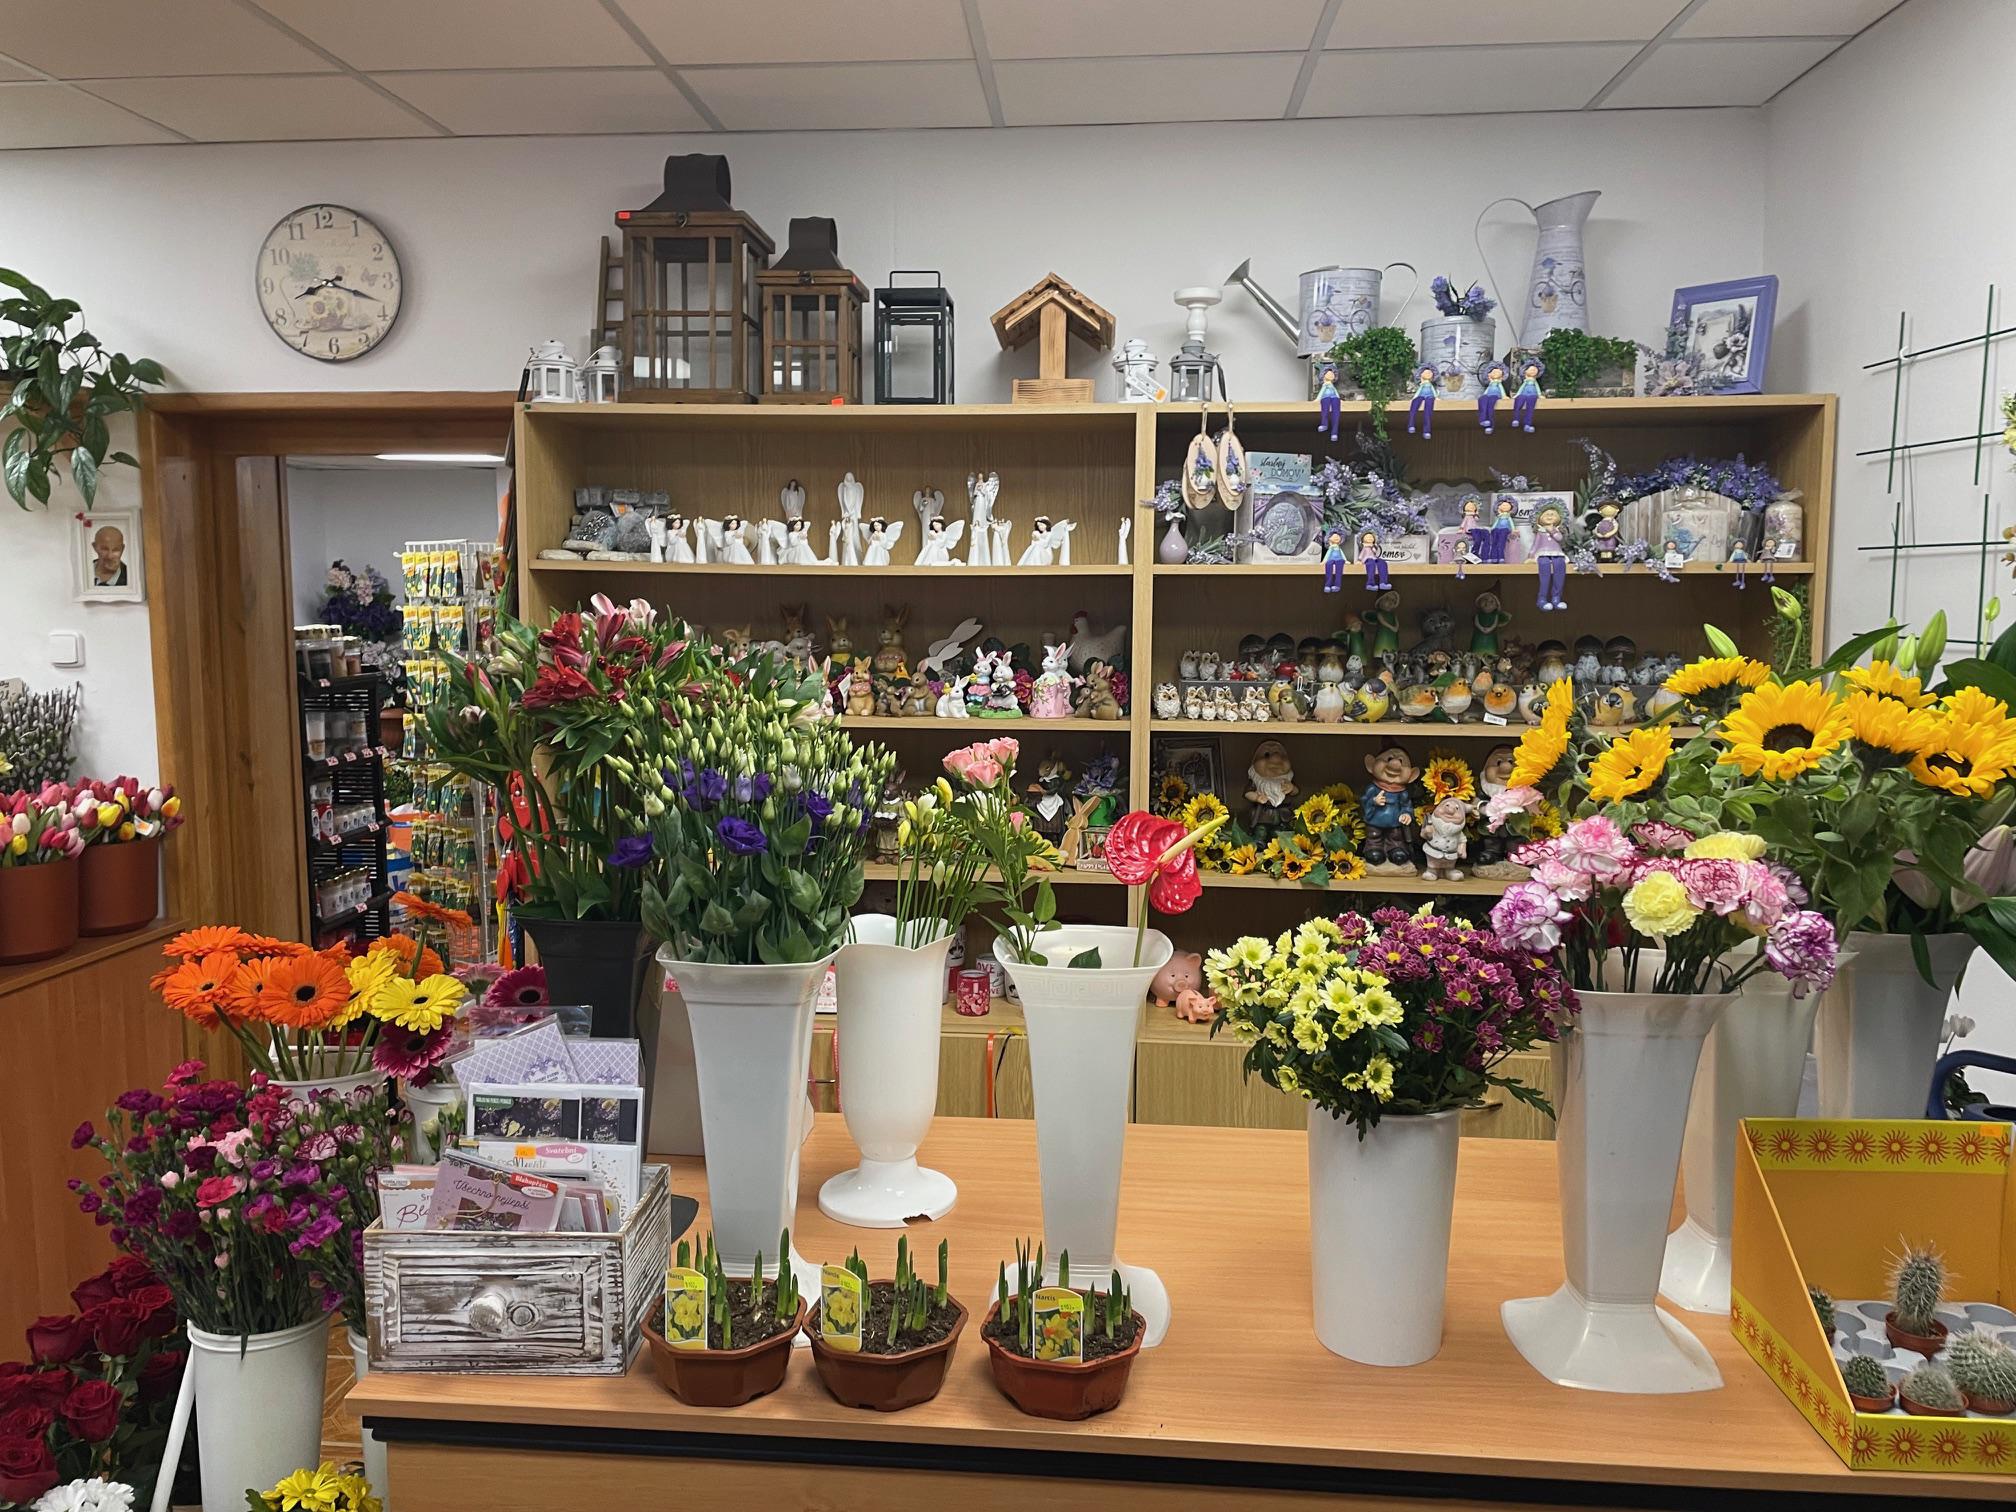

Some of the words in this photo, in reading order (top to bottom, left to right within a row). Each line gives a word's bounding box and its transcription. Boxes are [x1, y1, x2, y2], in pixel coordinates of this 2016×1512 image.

[314, 211, 334, 230] 12
[352, 220, 359, 237] 1
[288, 223, 306, 241] 11
[270, 248, 290, 266] 10
[372, 243, 384, 261] 2
[263, 277, 274, 295] 9
[382, 272, 394, 290] 3
[275, 307, 287, 326] 8
[377, 305, 389, 321] 4
[328, 336, 340, 354] 6
